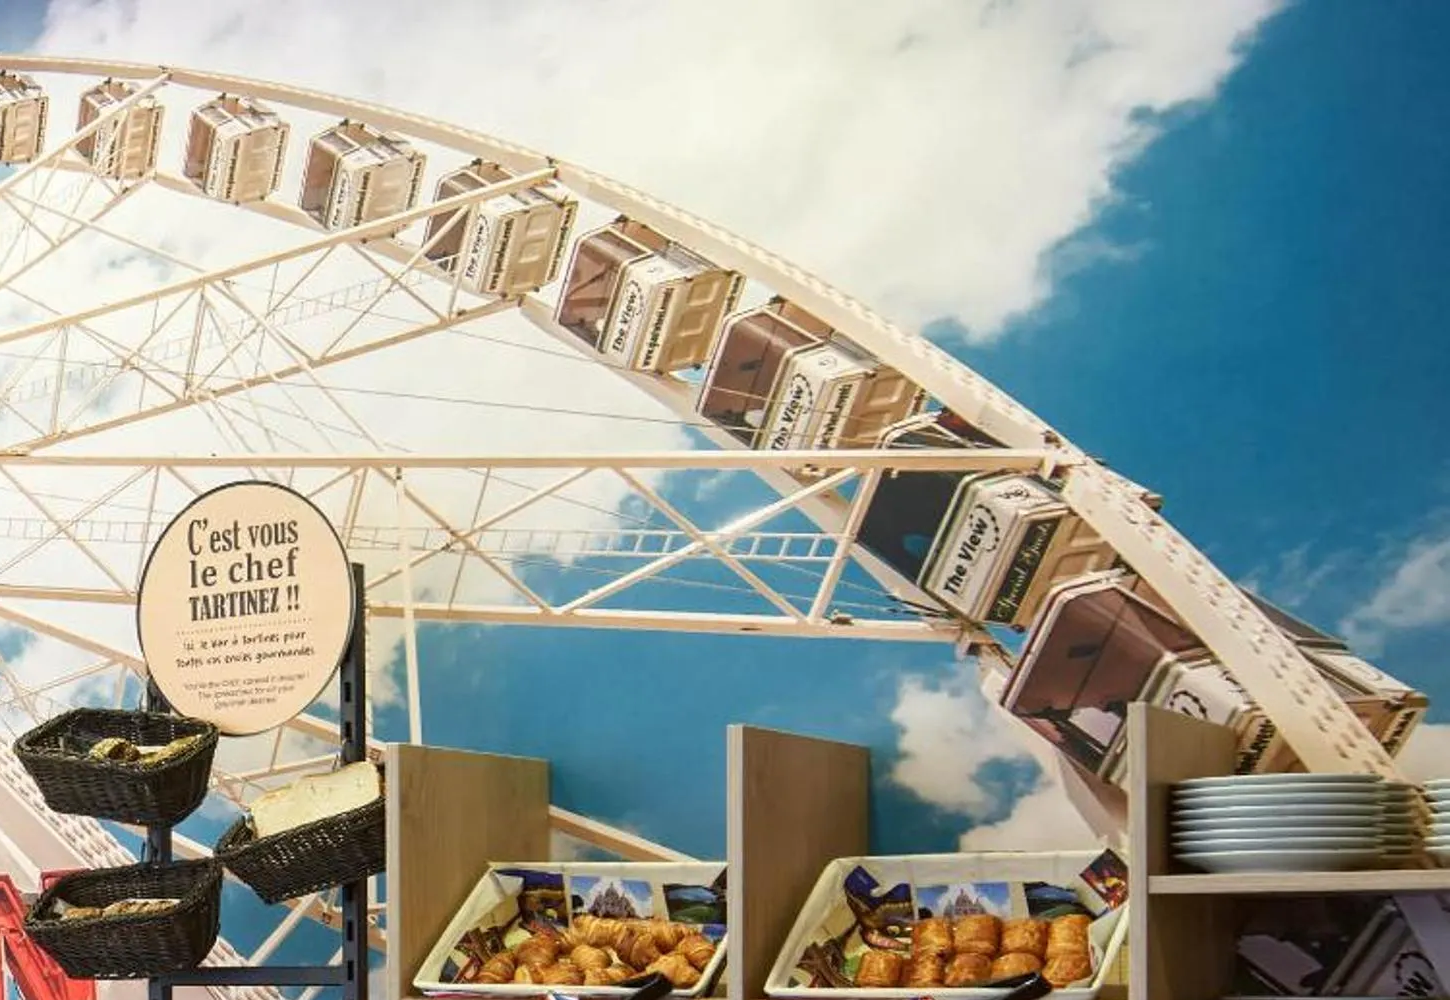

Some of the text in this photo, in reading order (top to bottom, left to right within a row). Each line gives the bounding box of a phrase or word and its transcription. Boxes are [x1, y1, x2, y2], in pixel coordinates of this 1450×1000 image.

[781, 384, 804, 424] View
[188, 518, 299, 556] C'est vous
[943, 517, 989, 595] The View
[189, 546, 299, 588] le chef
[188, 586, 280, 622] TARTINEZ
